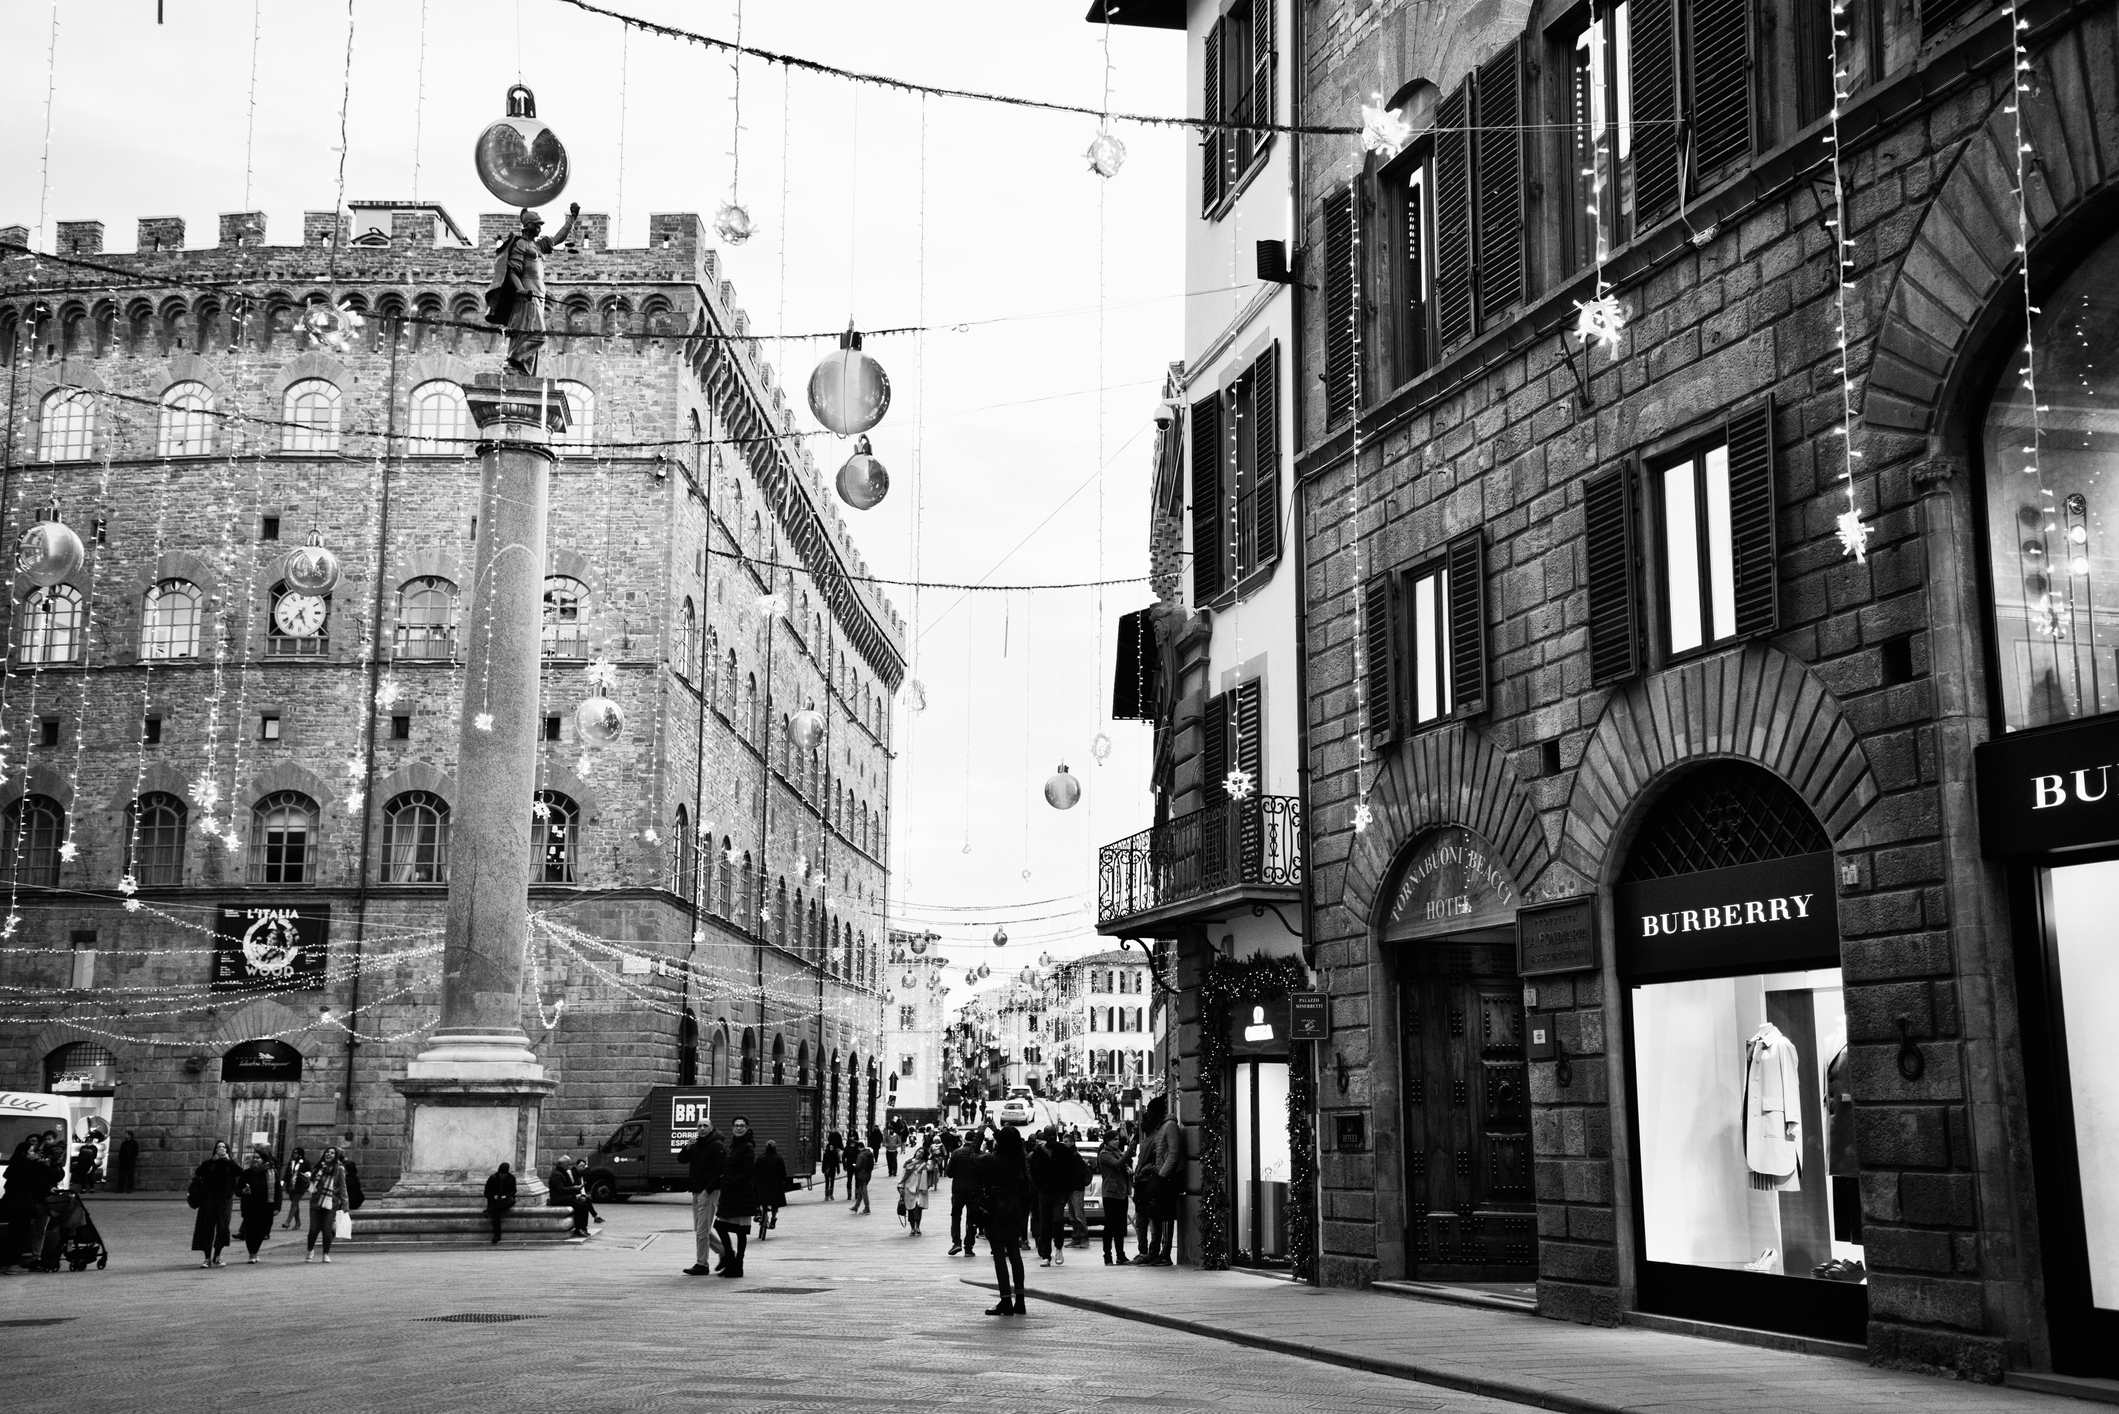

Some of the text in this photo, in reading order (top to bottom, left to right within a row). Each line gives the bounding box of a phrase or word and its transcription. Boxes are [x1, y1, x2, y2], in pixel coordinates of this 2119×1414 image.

[2030, 764, 2119, 810] BU
[1391, 846, 1513, 922] TORNABUONI BEACCI
[247, 908, 300, 919] L'ITALIA
[1426, 895, 1470, 920] HOTEL
[1641, 893, 1814, 937] BURBERRY
[1538, 927, 1590, 947] FONDIARIA
[244, 965, 295, 977] WOOD
[675, 1104, 707, 1122] BRT
[671, 1131, 699, 1139] CORRIE
